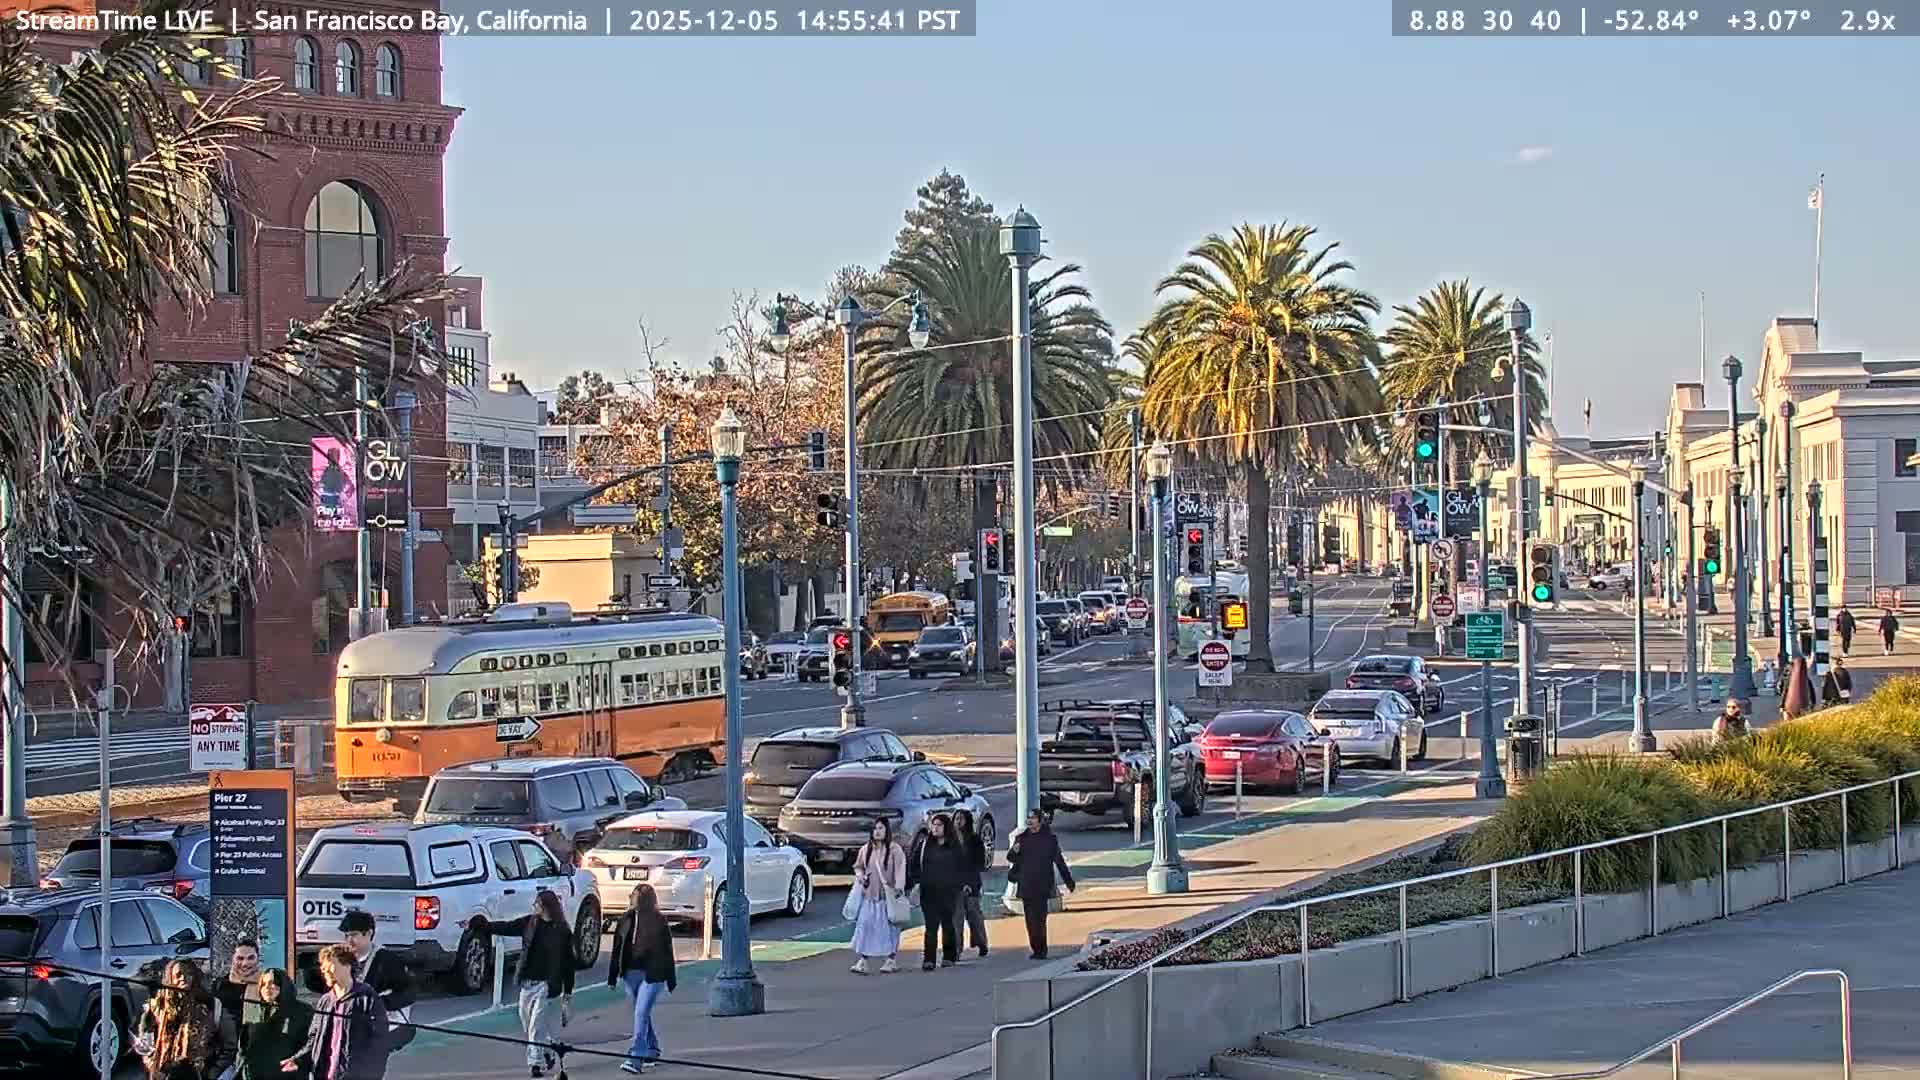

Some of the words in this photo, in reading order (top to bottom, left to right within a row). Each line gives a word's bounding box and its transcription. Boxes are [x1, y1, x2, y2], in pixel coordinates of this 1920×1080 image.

[368, 440, 400, 460] GL
[367, 461, 407, 481] OW
[1446, 491, 1468, 503] GL
[317, 506, 336, 517] Play
[1177, 503, 1199, 515] OW
[1446, 503, 1471, 514] OW
[192, 723, 209, 734] NO
[211, 724, 245, 734] STOPPING
[508, 724, 522, 734] WAY
[197, 741, 216, 752] ANY
[218, 740, 240, 752] TIME
[214, 793, 233, 803] Pier
[235, 793, 247, 803] 27
[302, 900, 343, 916] OTIS
